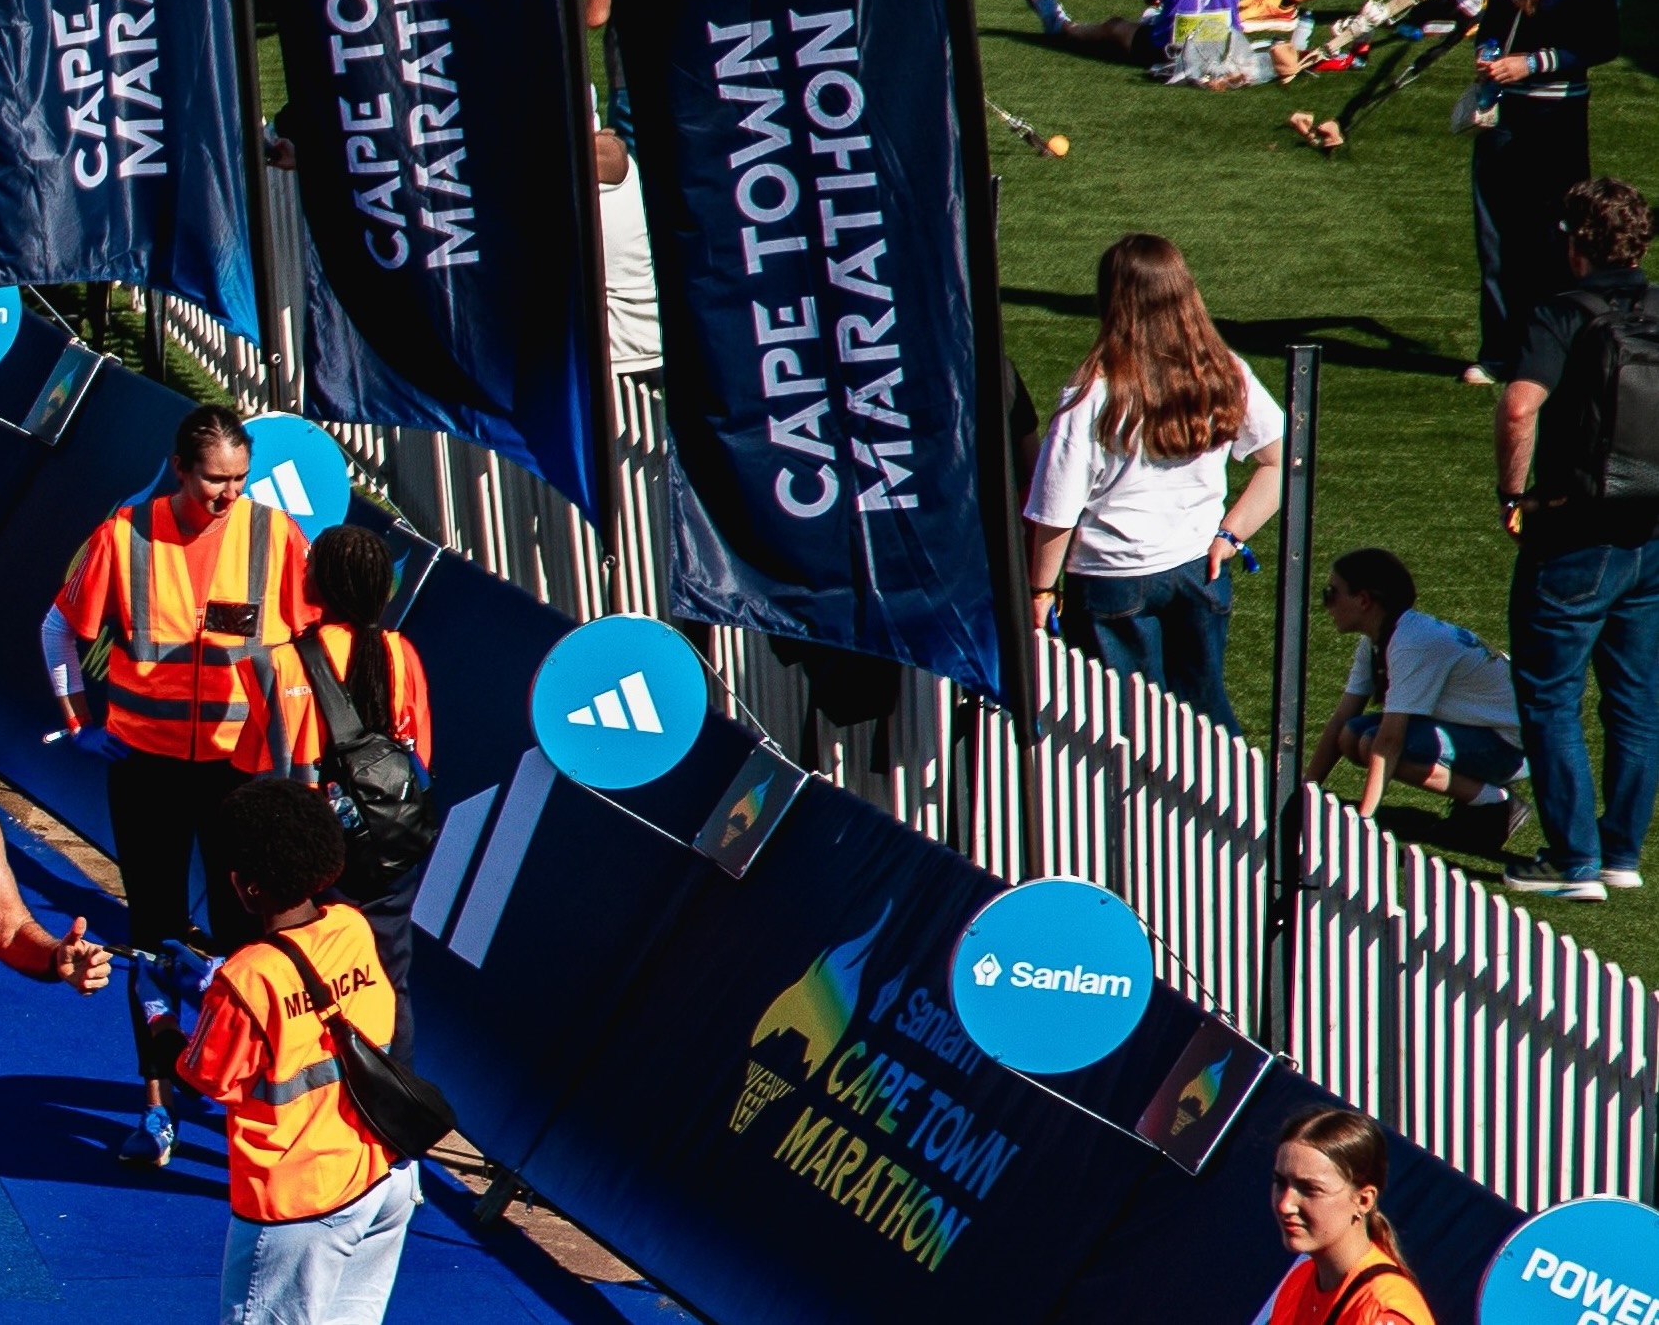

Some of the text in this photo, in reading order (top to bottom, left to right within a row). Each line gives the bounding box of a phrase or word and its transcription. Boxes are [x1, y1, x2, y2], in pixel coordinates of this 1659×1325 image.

[53, 3, 110, 191] CAPE
[339, 93, 410, 270] CAPE
[707, 18, 840, 518] CAPE TOWN
[790, 7, 921, 514] MARATHON
[284, 965, 377, 1020] MEICAL
[1011, 963, 1132, 999] Sanlam
[773, 1106, 972, 1273] MARATHON
[826, 1040, 1022, 1202] CAPE TOWN
